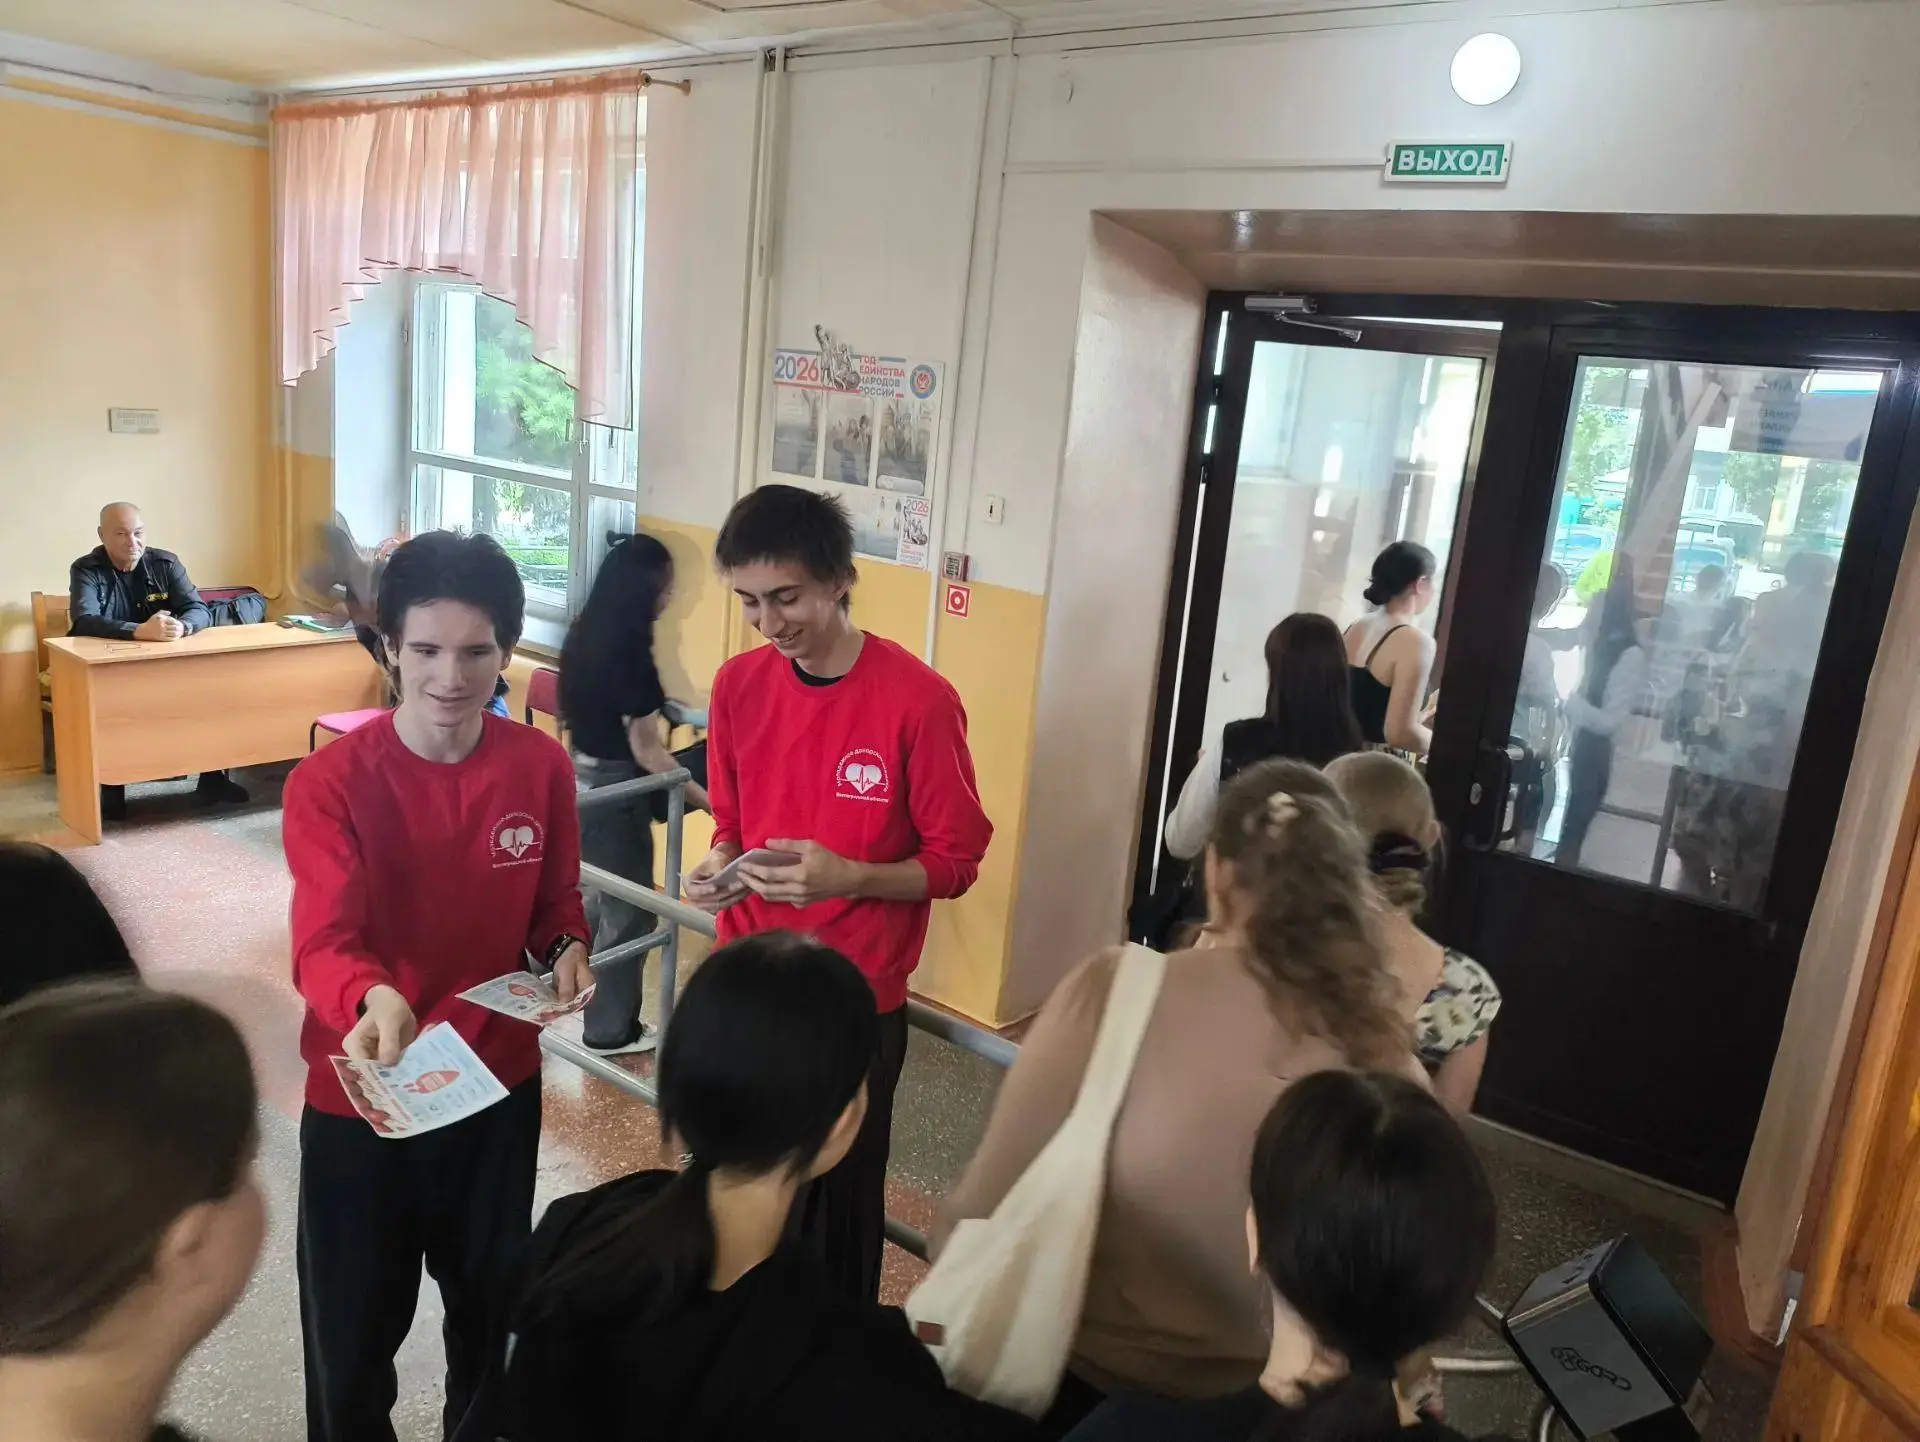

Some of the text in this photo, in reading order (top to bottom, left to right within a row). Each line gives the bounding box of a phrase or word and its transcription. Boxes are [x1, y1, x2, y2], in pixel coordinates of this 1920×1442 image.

[1398, 149, 1498, 175] ВЫХОД
[860, 355, 876, 365] ГОД
[774, 354, 820, 382] 2026
[860, 365, 905, 377] ЕДИНСТВА
[860, 376, 901, 388] НАРОДОВ
[905, 499, 929, 513] 2026
